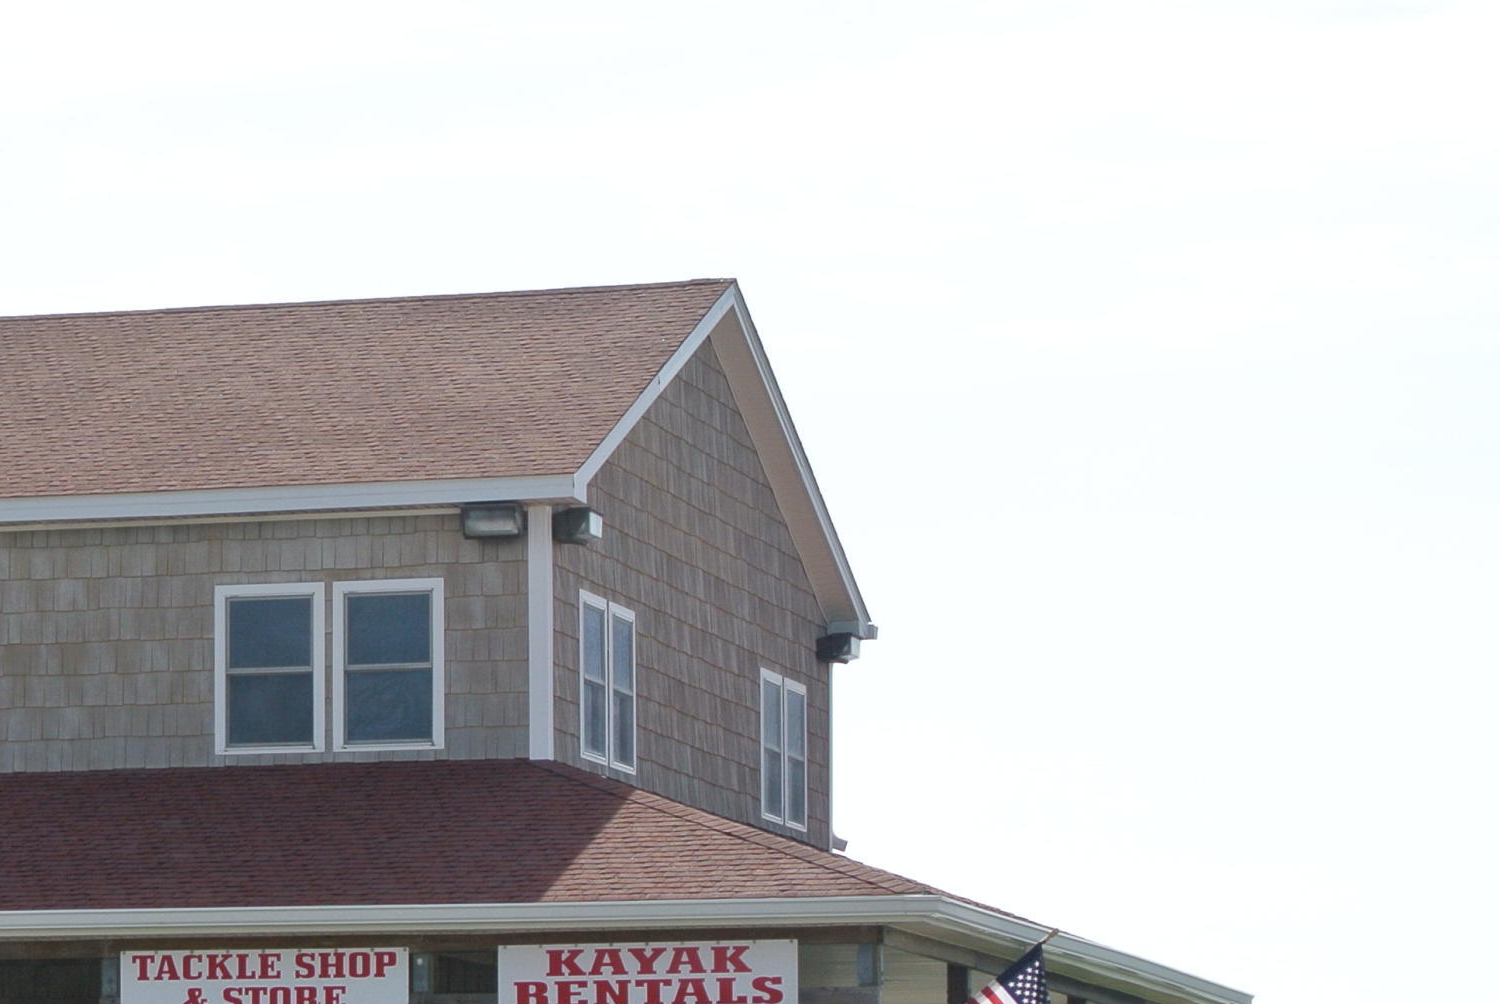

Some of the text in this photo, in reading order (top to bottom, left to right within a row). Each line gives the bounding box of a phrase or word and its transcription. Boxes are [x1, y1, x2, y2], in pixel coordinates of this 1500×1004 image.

[131, 951, 397, 981] TACKLE SHOP
[546, 945, 752, 977] KAYAK
